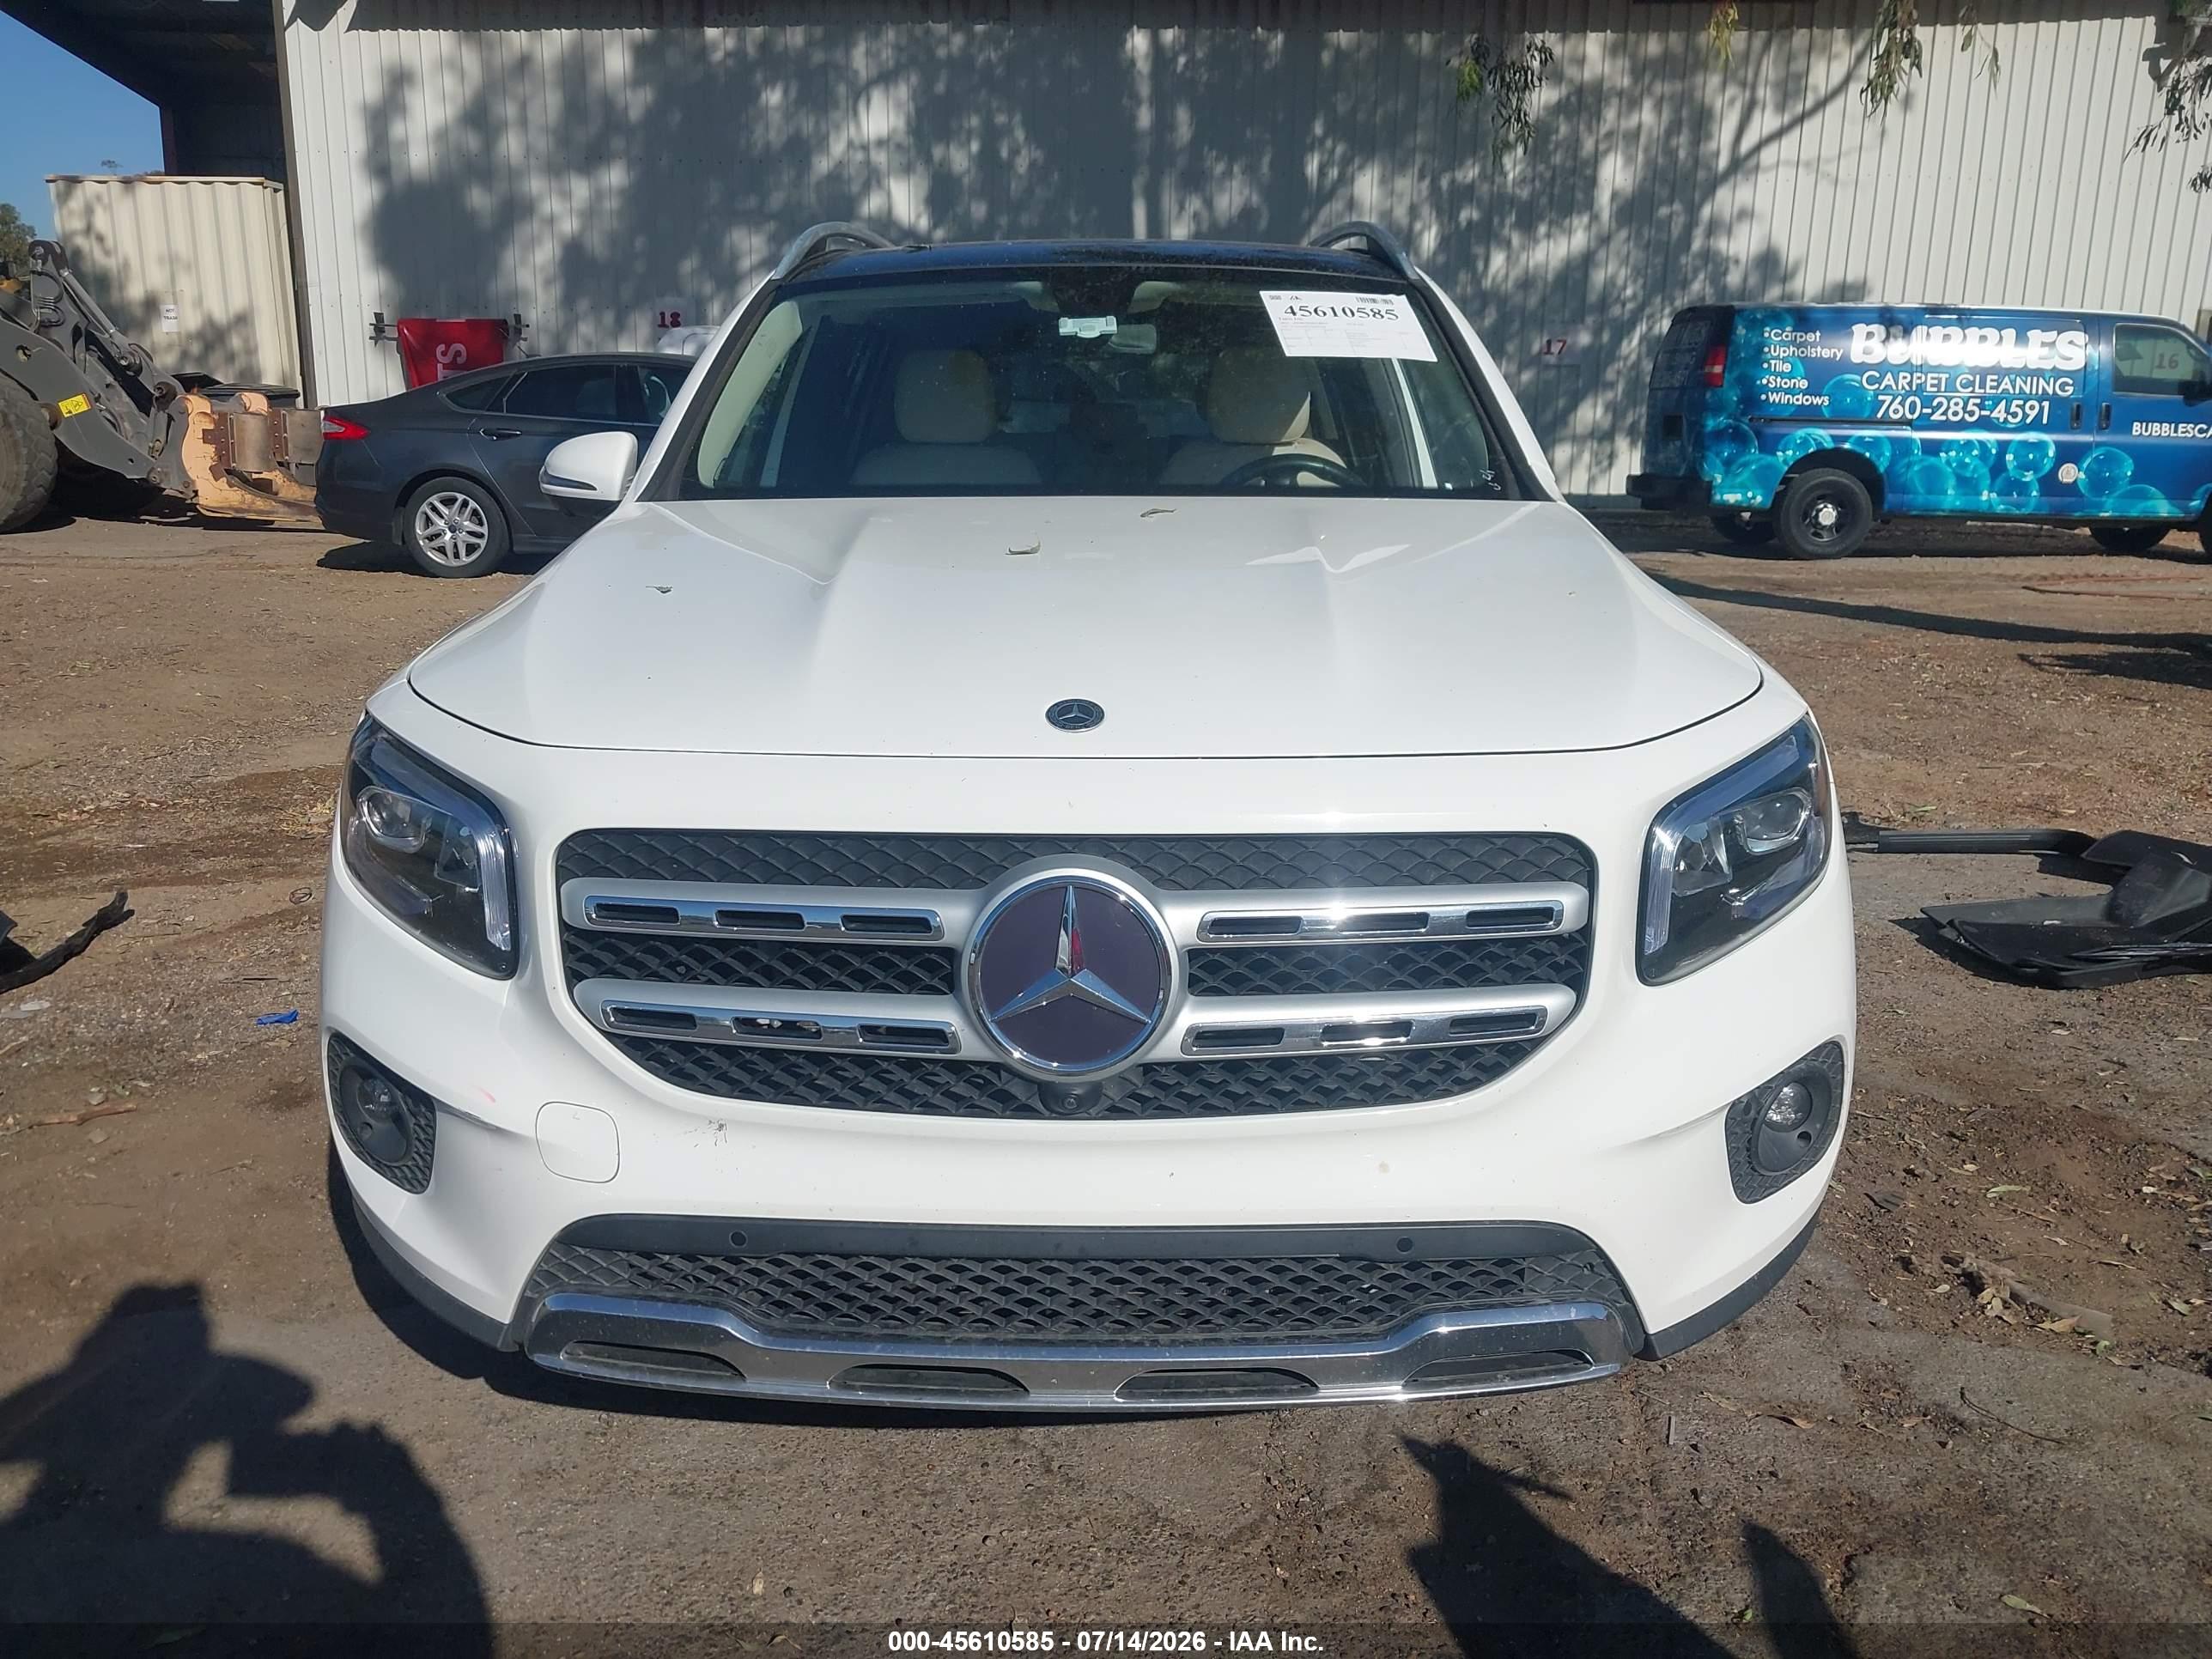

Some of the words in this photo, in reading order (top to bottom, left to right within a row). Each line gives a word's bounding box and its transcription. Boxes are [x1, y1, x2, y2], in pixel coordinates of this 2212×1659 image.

[657, 311, 682, 328] 18
[1284, 305, 1400, 321] 45610585
[1770, 329, 1821, 343] Carpet
[1543, 338, 1567, 356] 17
[1770, 344, 1844, 362] Upholstery
[1769, 360, 1792, 373] Tile
[2155, 353, 2179, 369] 16
[1768, 375, 1808, 389] Stone
[1862, 370, 1950, 392] CARPET
[1955, 374, 2075, 397] CLEANING
[1768, 392, 1830, 406] Windows
[1876, 394, 2051, 425] 760-285-4591
